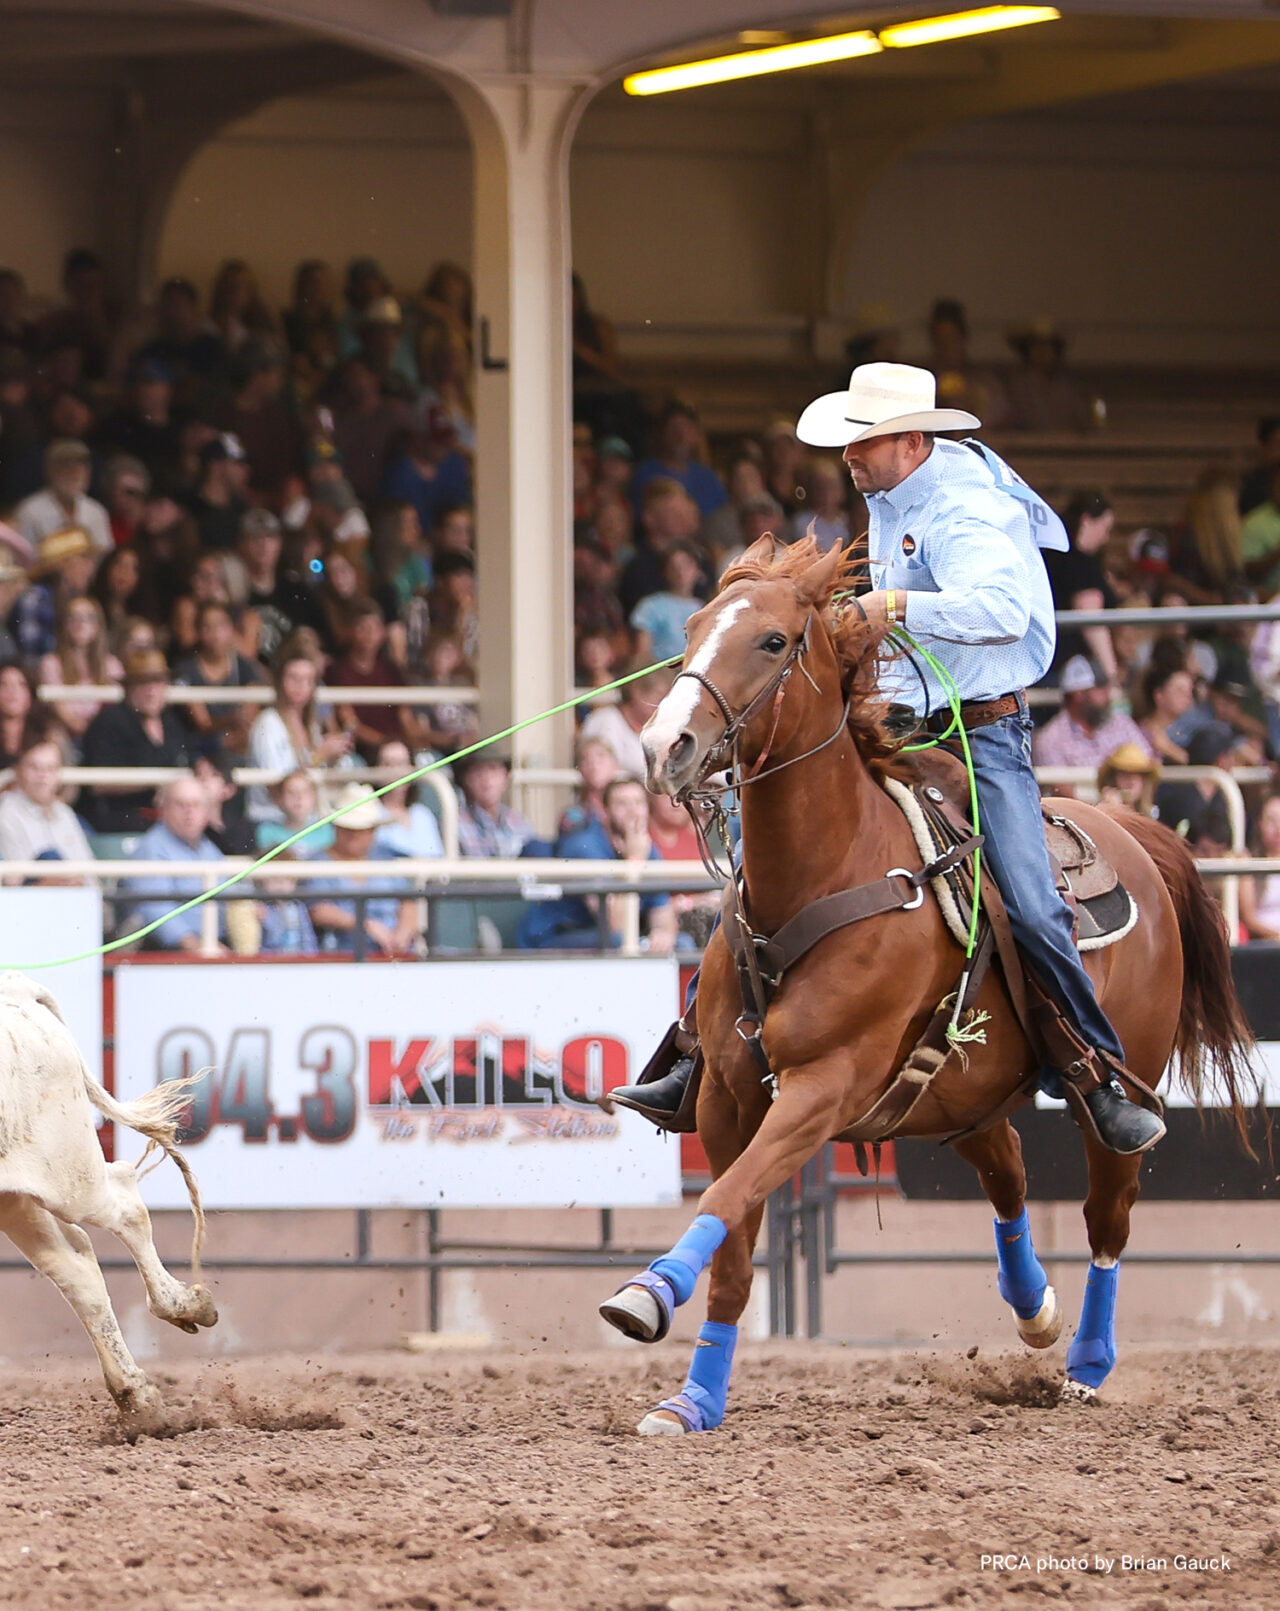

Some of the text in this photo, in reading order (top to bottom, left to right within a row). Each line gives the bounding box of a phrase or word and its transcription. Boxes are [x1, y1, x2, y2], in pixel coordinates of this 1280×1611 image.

[480, 316, 508, 371] L
[156, 1025, 630, 1144] 94.3 KILO
